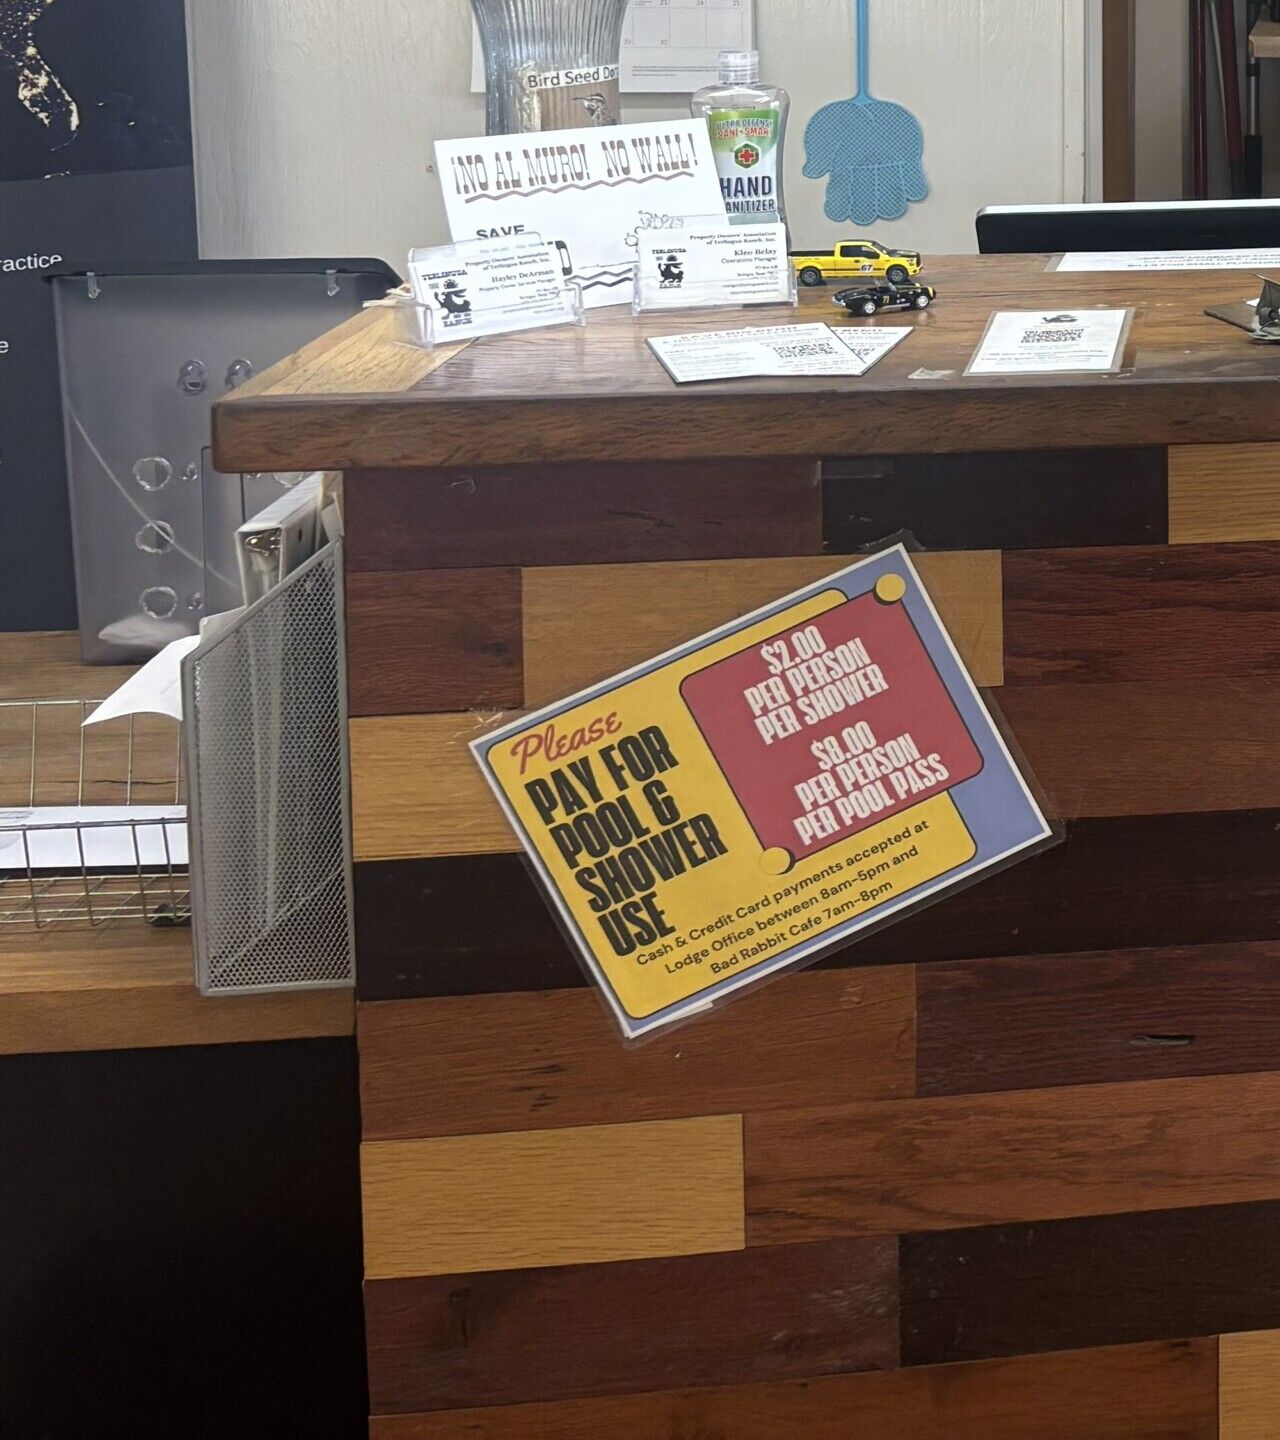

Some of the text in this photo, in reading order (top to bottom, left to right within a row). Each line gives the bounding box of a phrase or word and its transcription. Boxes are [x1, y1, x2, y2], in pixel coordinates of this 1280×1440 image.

[528, 68, 599, 88] Bird Seed
[452, 133, 698, 195] ¡NO AL MURO! NO WALL!
[720, 176, 772, 197] HAND
[476, 224, 525, 239] SAVE
[725, 199, 775, 214] ANITIZER
[0, 254, 62, 271] actice
[744, 637, 872, 716] PER PERSON
[760, 625, 827, 675] $2.00
[754, 664, 889, 745] PER SHOWER
[511, 712, 622, 775] Please
[794, 733, 921, 811] PER PERSON
[810, 721, 877, 771] $8.00
[524, 726, 679, 826] PAY FOR
[793, 753, 950, 845] PER POOL PASS
[549, 779, 681, 870] POOL &
[574, 813, 728, 913] SHOWER
[597, 891, 676, 957] USE
